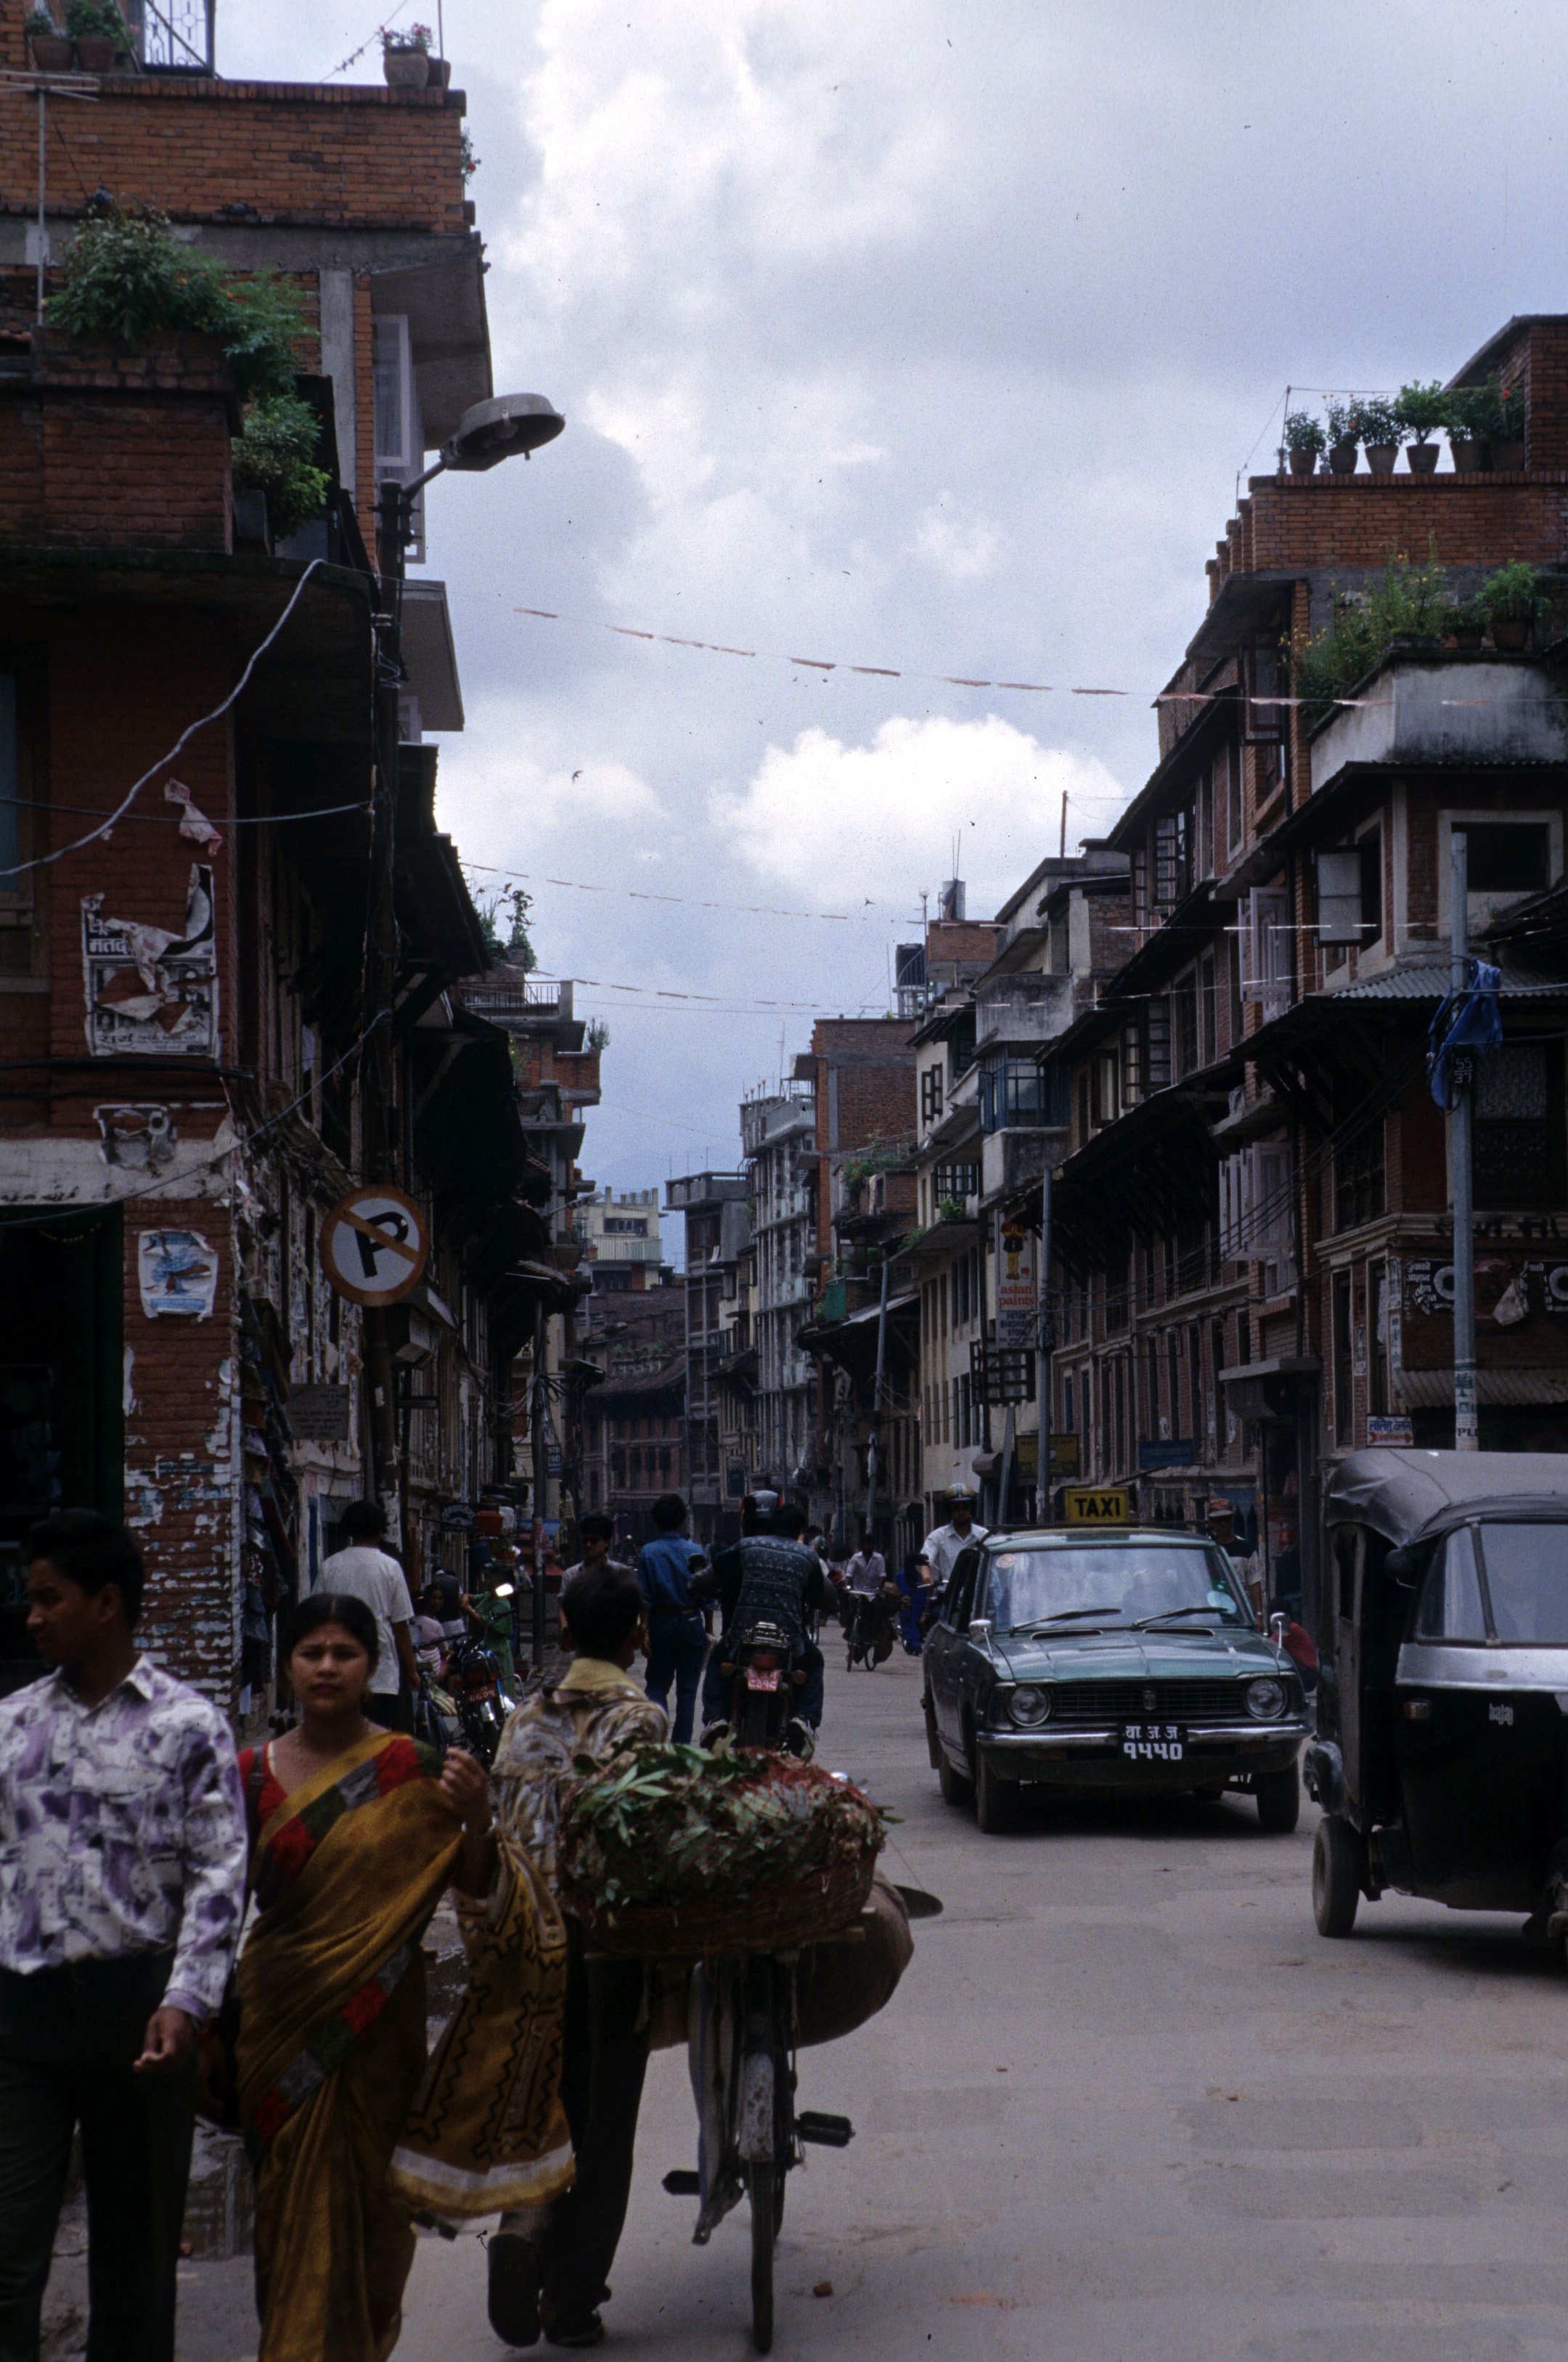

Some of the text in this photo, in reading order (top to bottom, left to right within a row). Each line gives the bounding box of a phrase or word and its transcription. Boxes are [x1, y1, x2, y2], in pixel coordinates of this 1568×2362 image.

[355, 1212, 408, 1278] P
[1001, 1284, 1032, 1294] asian
[999, 1296, 1034, 1310] paints
[1074, 1497, 1120, 1518] TAXI
[1489, 1702, 1514, 1726] bajaj
